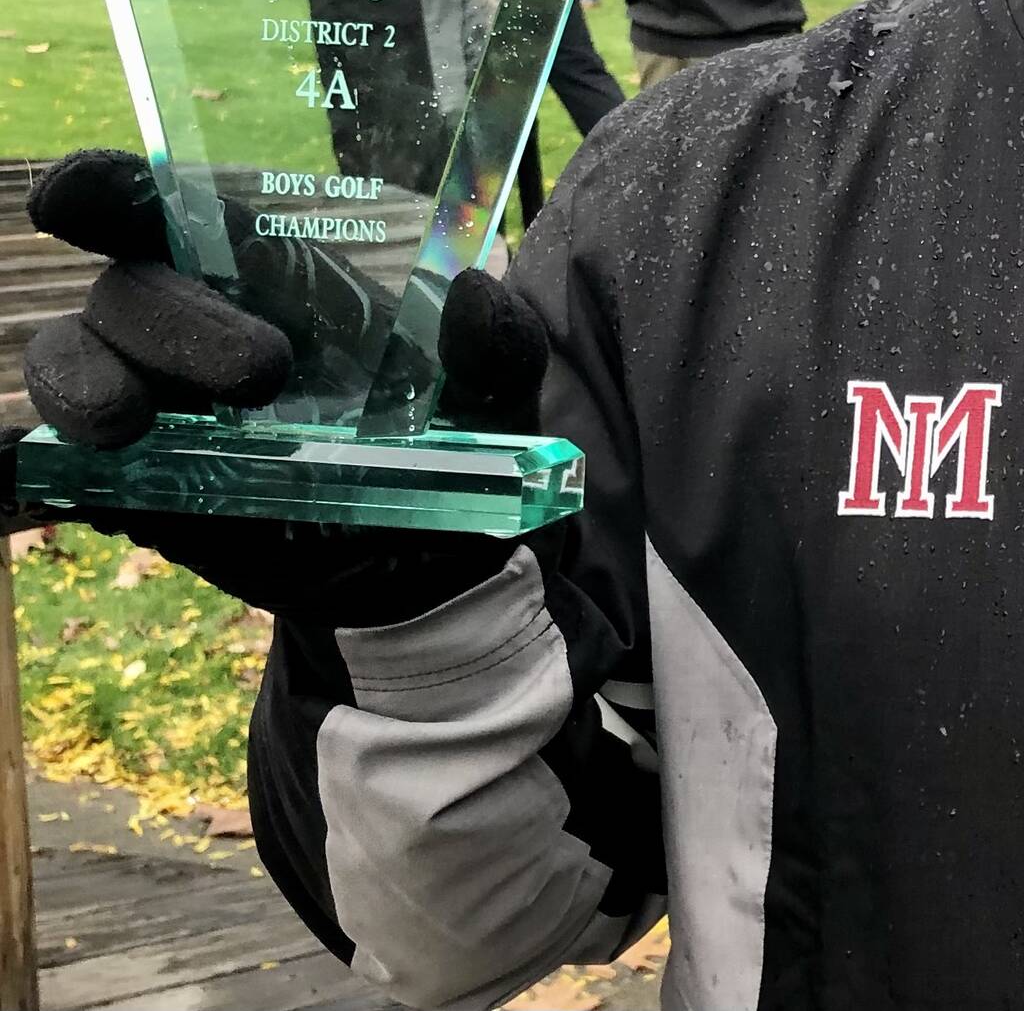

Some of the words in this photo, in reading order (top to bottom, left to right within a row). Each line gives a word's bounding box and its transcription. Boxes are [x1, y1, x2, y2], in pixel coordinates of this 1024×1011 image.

[261, 19, 374, 47] DISTRICT
[383, 25, 396, 48] 2
[295, 69, 356, 110] 4A
[260, 172, 316, 197] BOYS
[324, 175, 383, 200] GOLF
[255, 213, 386, 242] CHAMPIONS
